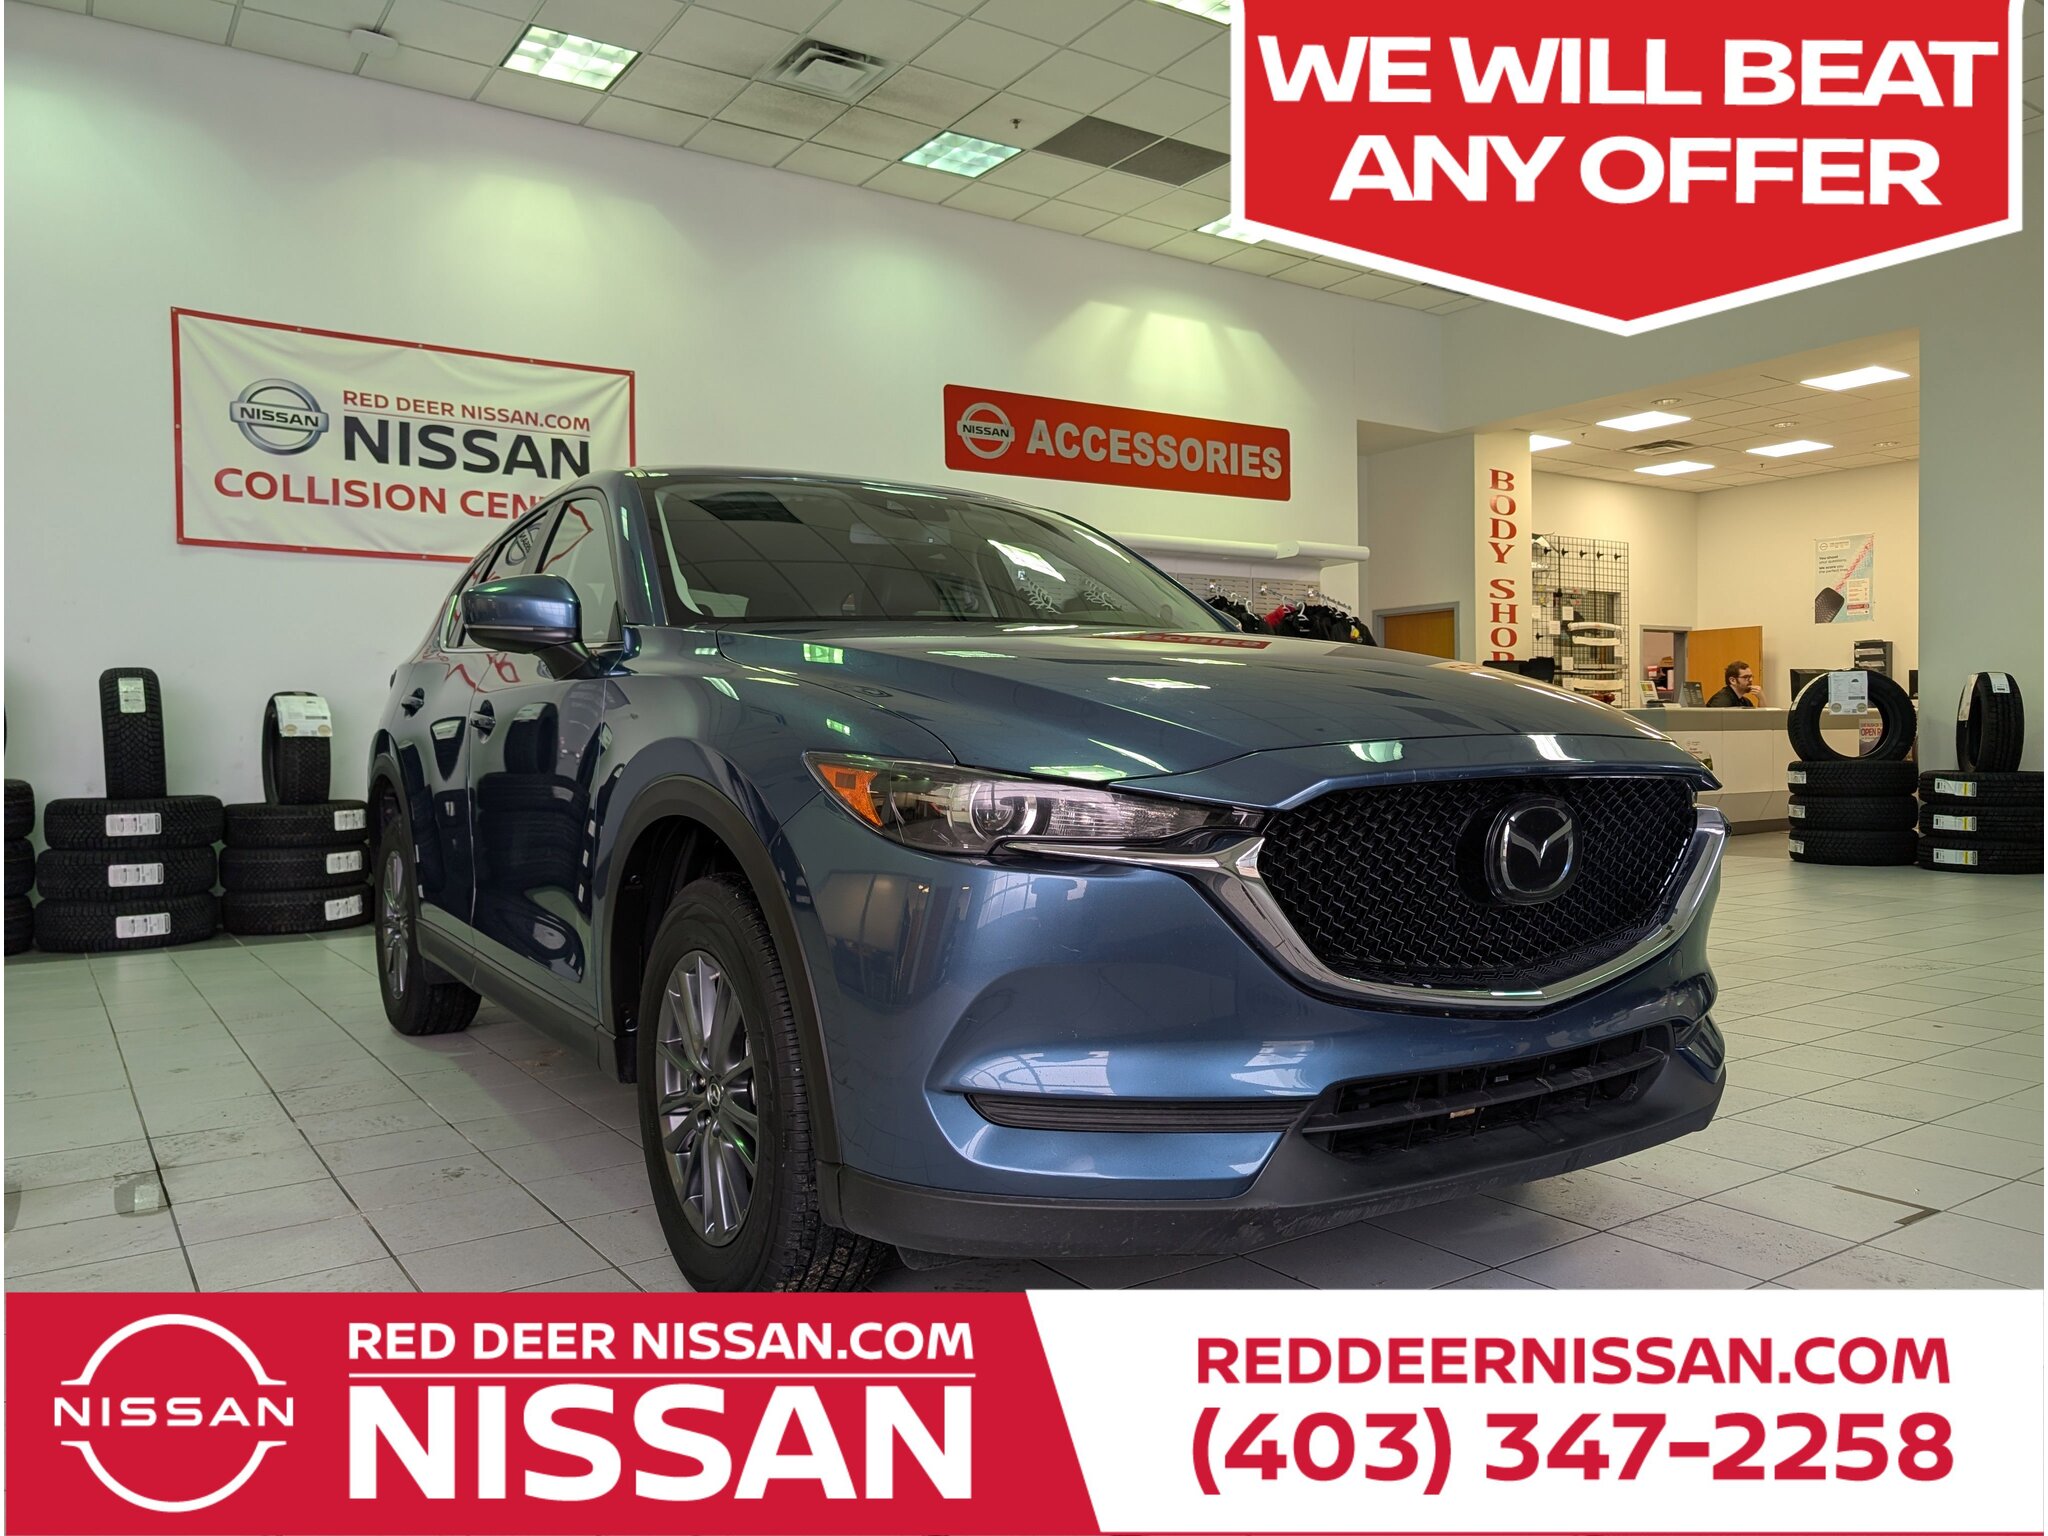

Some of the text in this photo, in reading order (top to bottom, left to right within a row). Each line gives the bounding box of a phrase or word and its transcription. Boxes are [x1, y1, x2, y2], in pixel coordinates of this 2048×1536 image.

[240, 407, 320, 428] NISSAN
[343, 390, 591, 432] RED DEER NISSAN.COM
[962, 423, 1010, 439] NISSAN
[343, 416, 590, 480] NISSAN
[1026, 418, 1283, 480] ACCESSORIES
[214, 467, 544, 520] COLLISION CEN
[1488, 468, 1519, 565] BODY
